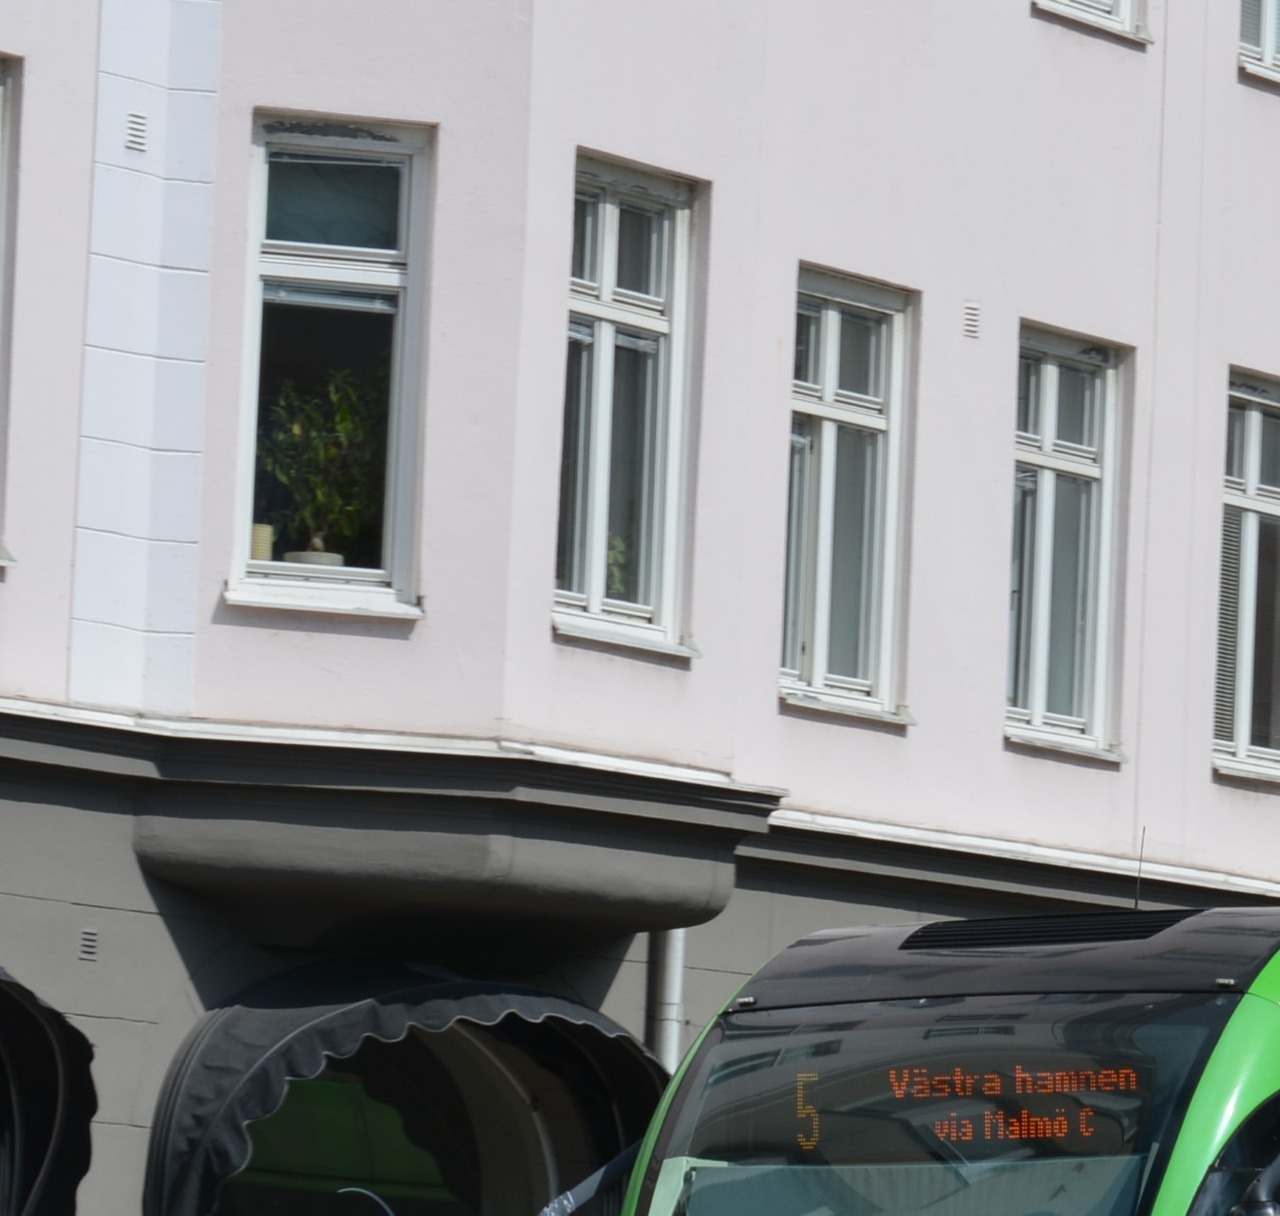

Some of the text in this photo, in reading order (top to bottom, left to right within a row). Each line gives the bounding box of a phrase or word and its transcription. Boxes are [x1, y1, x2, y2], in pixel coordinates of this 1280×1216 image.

[889, 1065, 1137, 1099] Västra hamnen
[796, 1072, 820, 1150] 5
[934, 1107, 1096, 1142] via Malmö C
